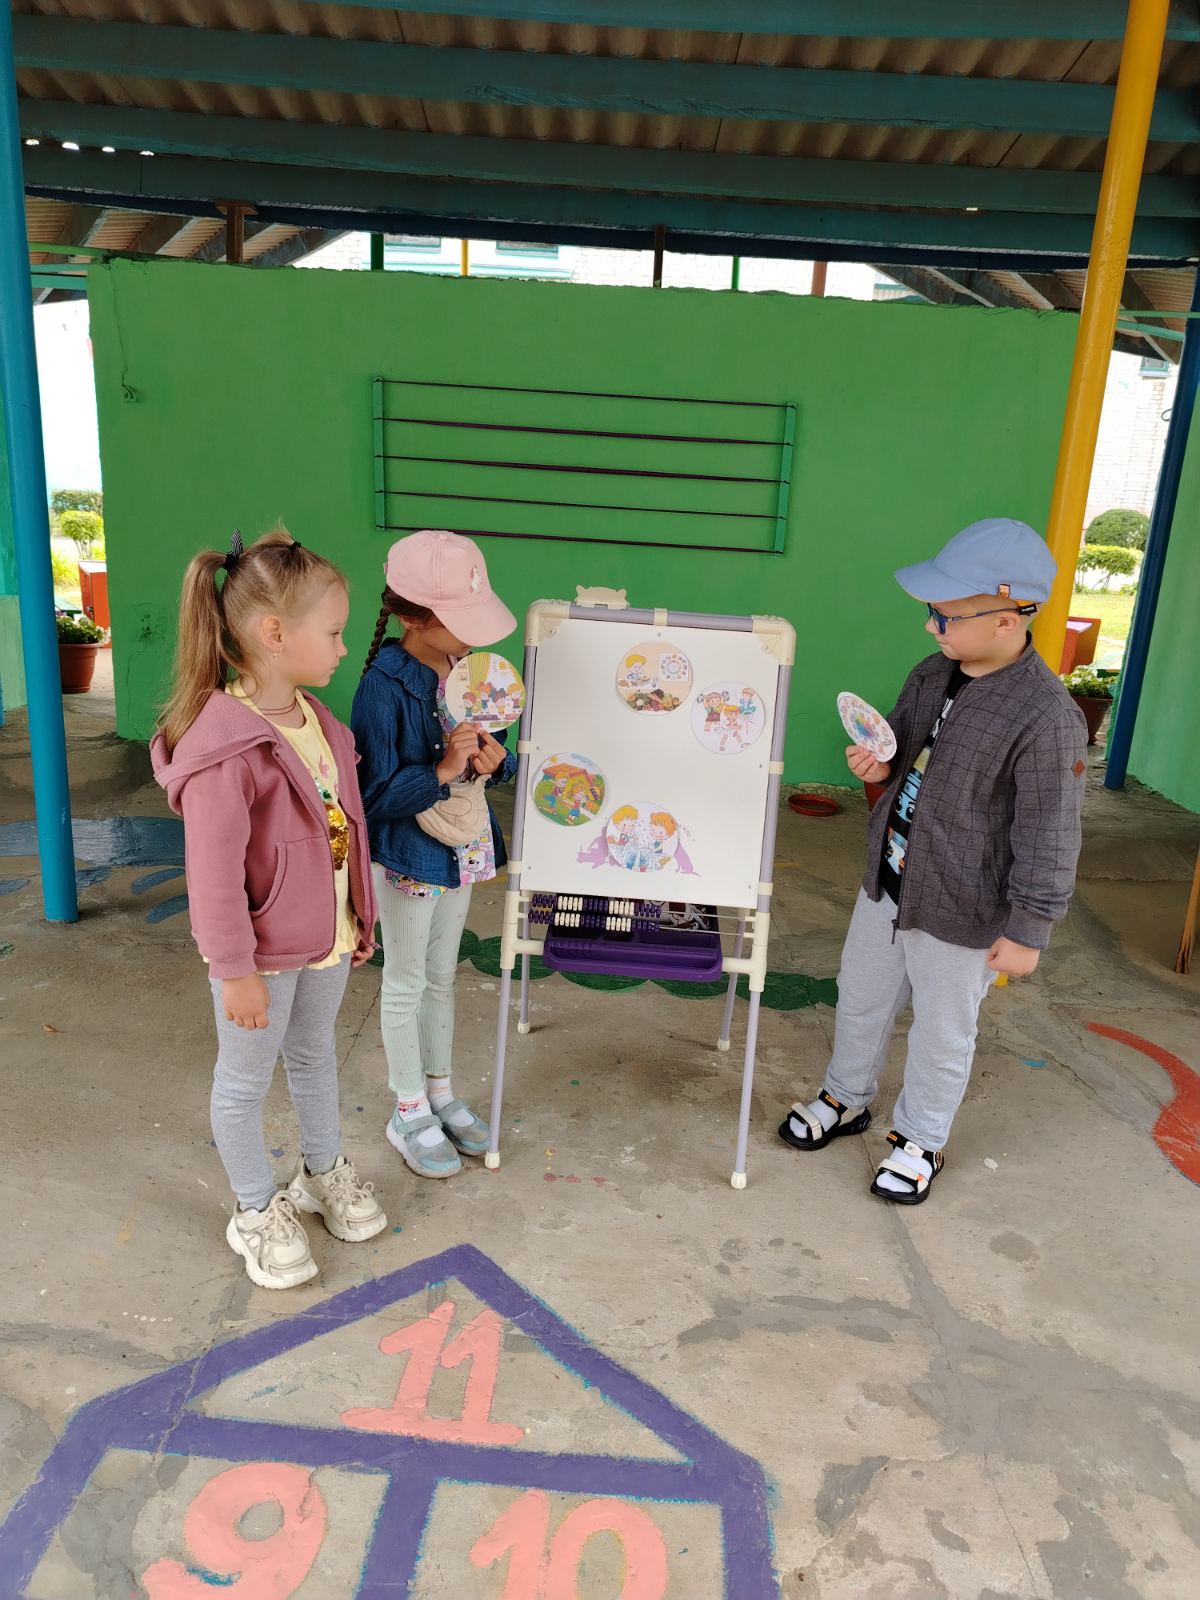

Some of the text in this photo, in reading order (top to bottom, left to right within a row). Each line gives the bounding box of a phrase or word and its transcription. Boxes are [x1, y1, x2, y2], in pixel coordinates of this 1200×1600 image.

[341, 1301, 525, 1446] 11
[141, 1462, 327, 1600] 9
[470, 1489, 668, 1600] 10
